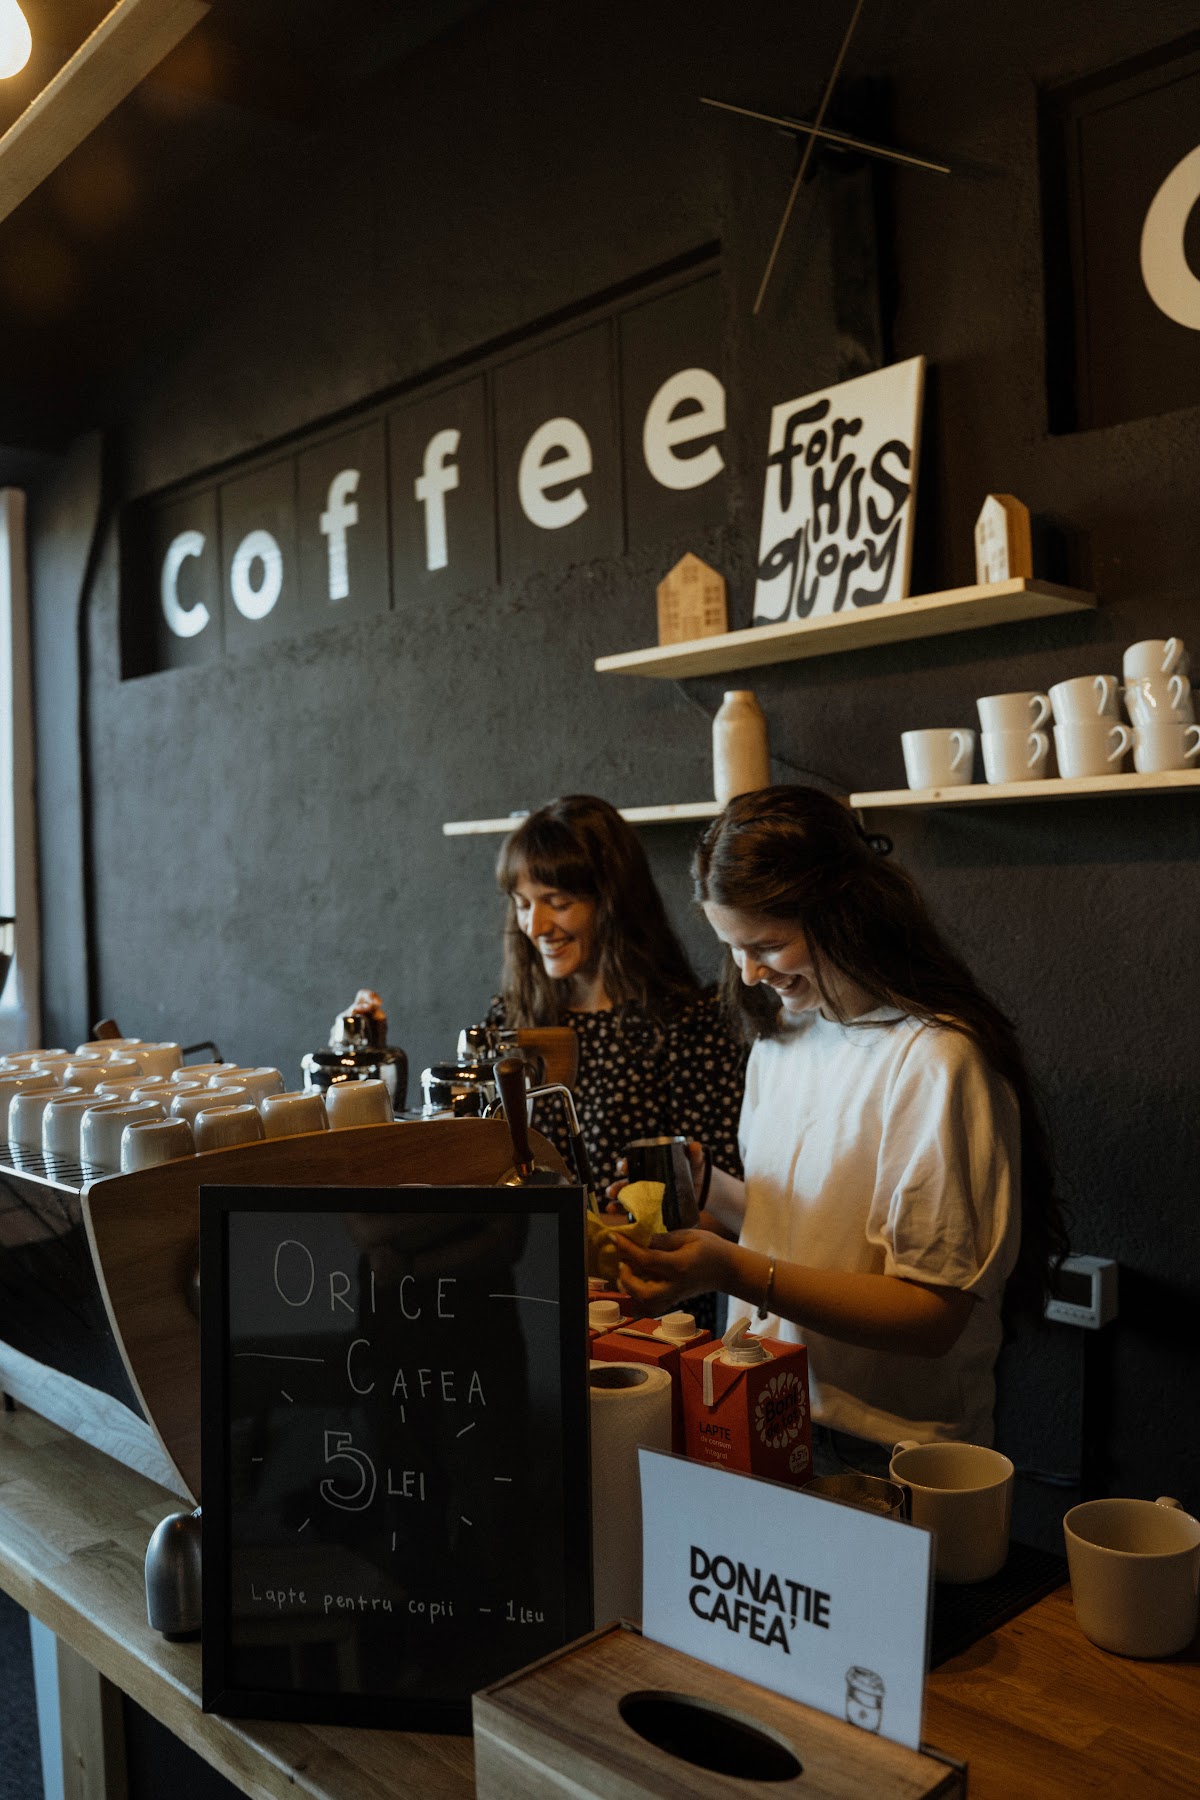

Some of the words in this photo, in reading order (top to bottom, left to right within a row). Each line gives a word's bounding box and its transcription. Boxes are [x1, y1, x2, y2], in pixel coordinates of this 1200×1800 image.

[161, 368, 726, 638] coffee
[812, 440, 911, 543] HIS
[755, 518, 902, 627] glory
[274, 1239, 457, 1320] ORICE
[346, 1338, 486, 1406] CAFEA
[699, 1421, 731, 1441] LAPTE
[709, 1438, 732, 1450] consum
[319, 1429, 377, 1511] 5
[387, 1468, 425, 1501] LEI
[251, 1583, 307, 1609] Lapte
[323, 1593, 393, 1614] pentru
[408, 1600, 454, 1624] copii
[688, 1584, 791, 1655] CAFEA
